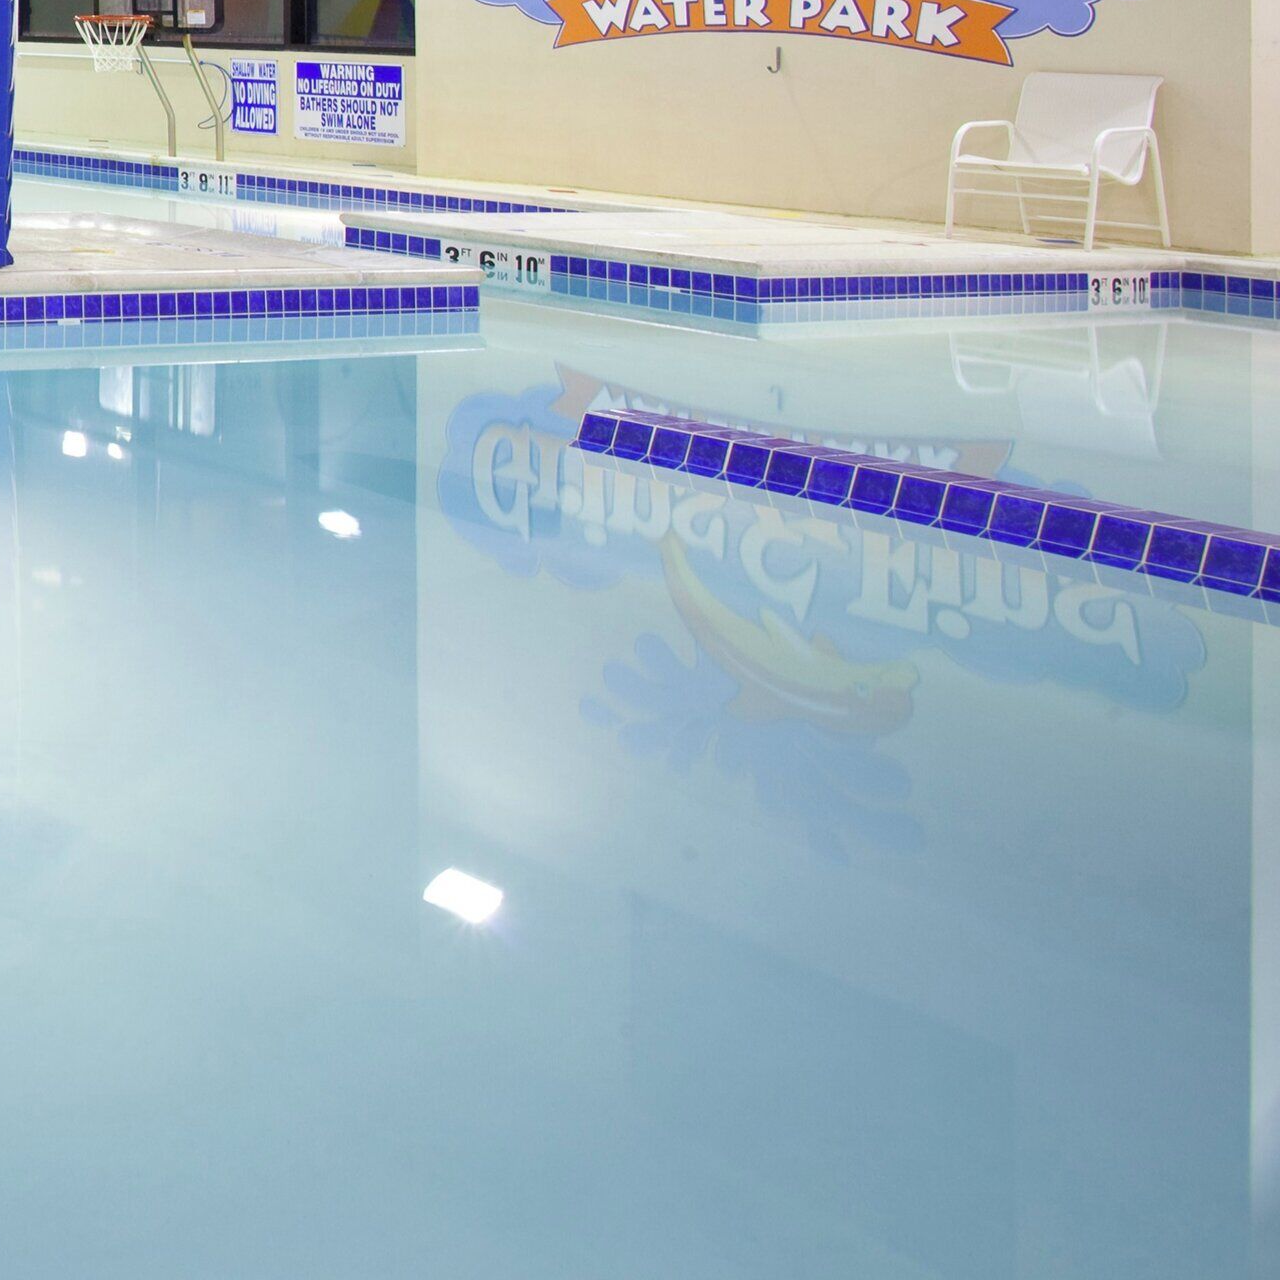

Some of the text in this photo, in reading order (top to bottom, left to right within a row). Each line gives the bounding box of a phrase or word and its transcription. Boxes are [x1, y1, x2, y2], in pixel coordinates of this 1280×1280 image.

[232, 62, 276, 78] SHALLOW WATER
[320, 63, 375, 81] WARNING
[247, 82, 275, 106] DIVING
[297, 78, 401, 99] NO LIFEGUARD ON DUTY
[300, 97, 399, 117] BATHERS SHOULD NOT
[235, 106, 275, 130] ALLOWED
[321, 113, 376, 130] SWIM ALONE
[445, 246, 460, 262] 3
[461, 248, 472, 257] FT
[497, 252, 508, 262] IN
